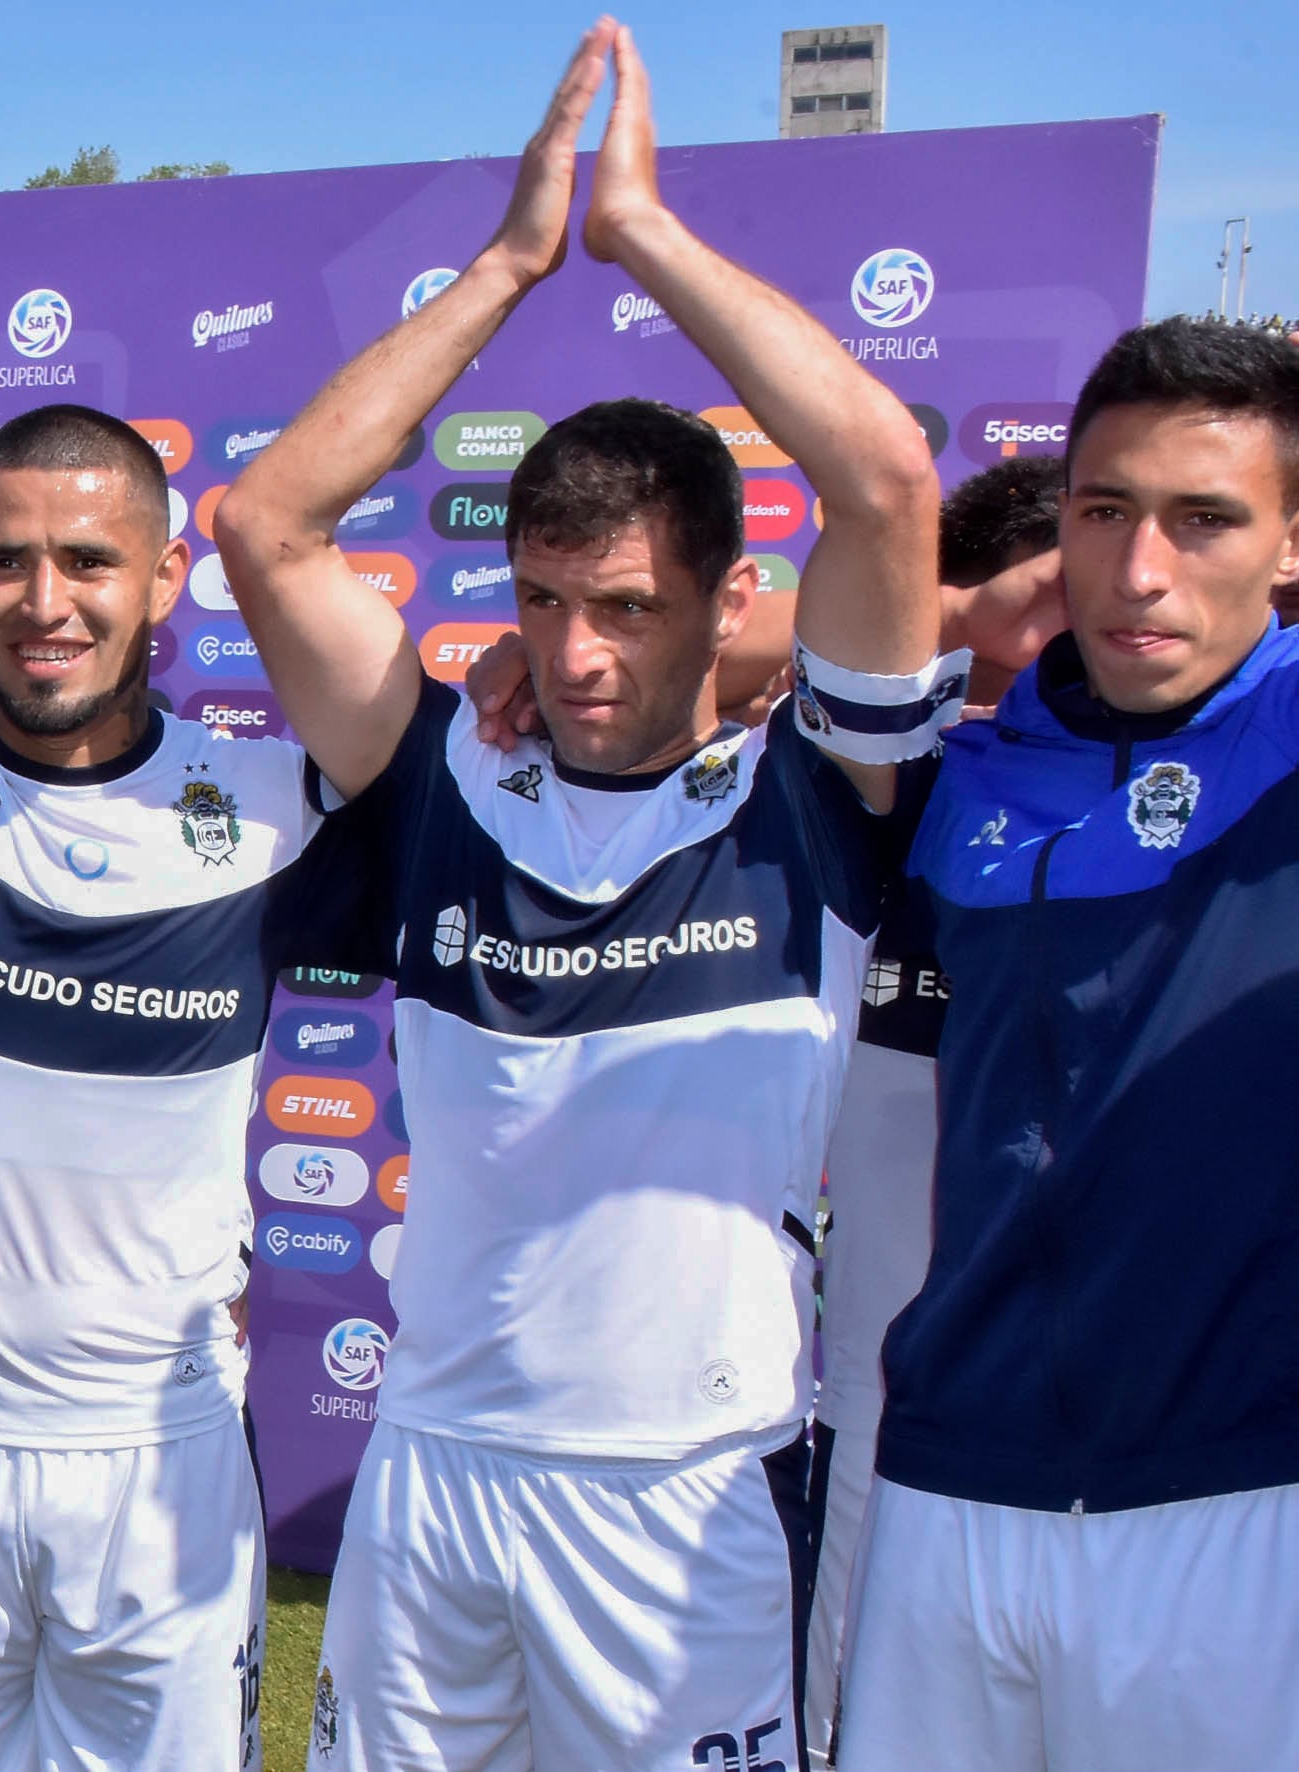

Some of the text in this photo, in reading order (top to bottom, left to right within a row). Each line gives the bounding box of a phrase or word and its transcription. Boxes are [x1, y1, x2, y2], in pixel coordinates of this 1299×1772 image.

[877, 279, 908, 296] SAF
[28, 315, 53, 330] SAF
[192, 300, 274, 348] Quilmes
[461, 425, 523, 441] BANCO
[456, 442, 526, 457] COMAFI
[451, 565, 512, 596] Quilmes
[90, 982, 240, 1020] SEGUROS
[297, 1022, 355, 1050] Quilmes
[281, 1095, 357, 1119] STIHL
[304, 1168, 324, 1181] SAF
[291, 1232, 351, 1256] cabify
[344, 1345, 372, 1361] SAF
[309, 1393, 378, 1422] SUPERLI
